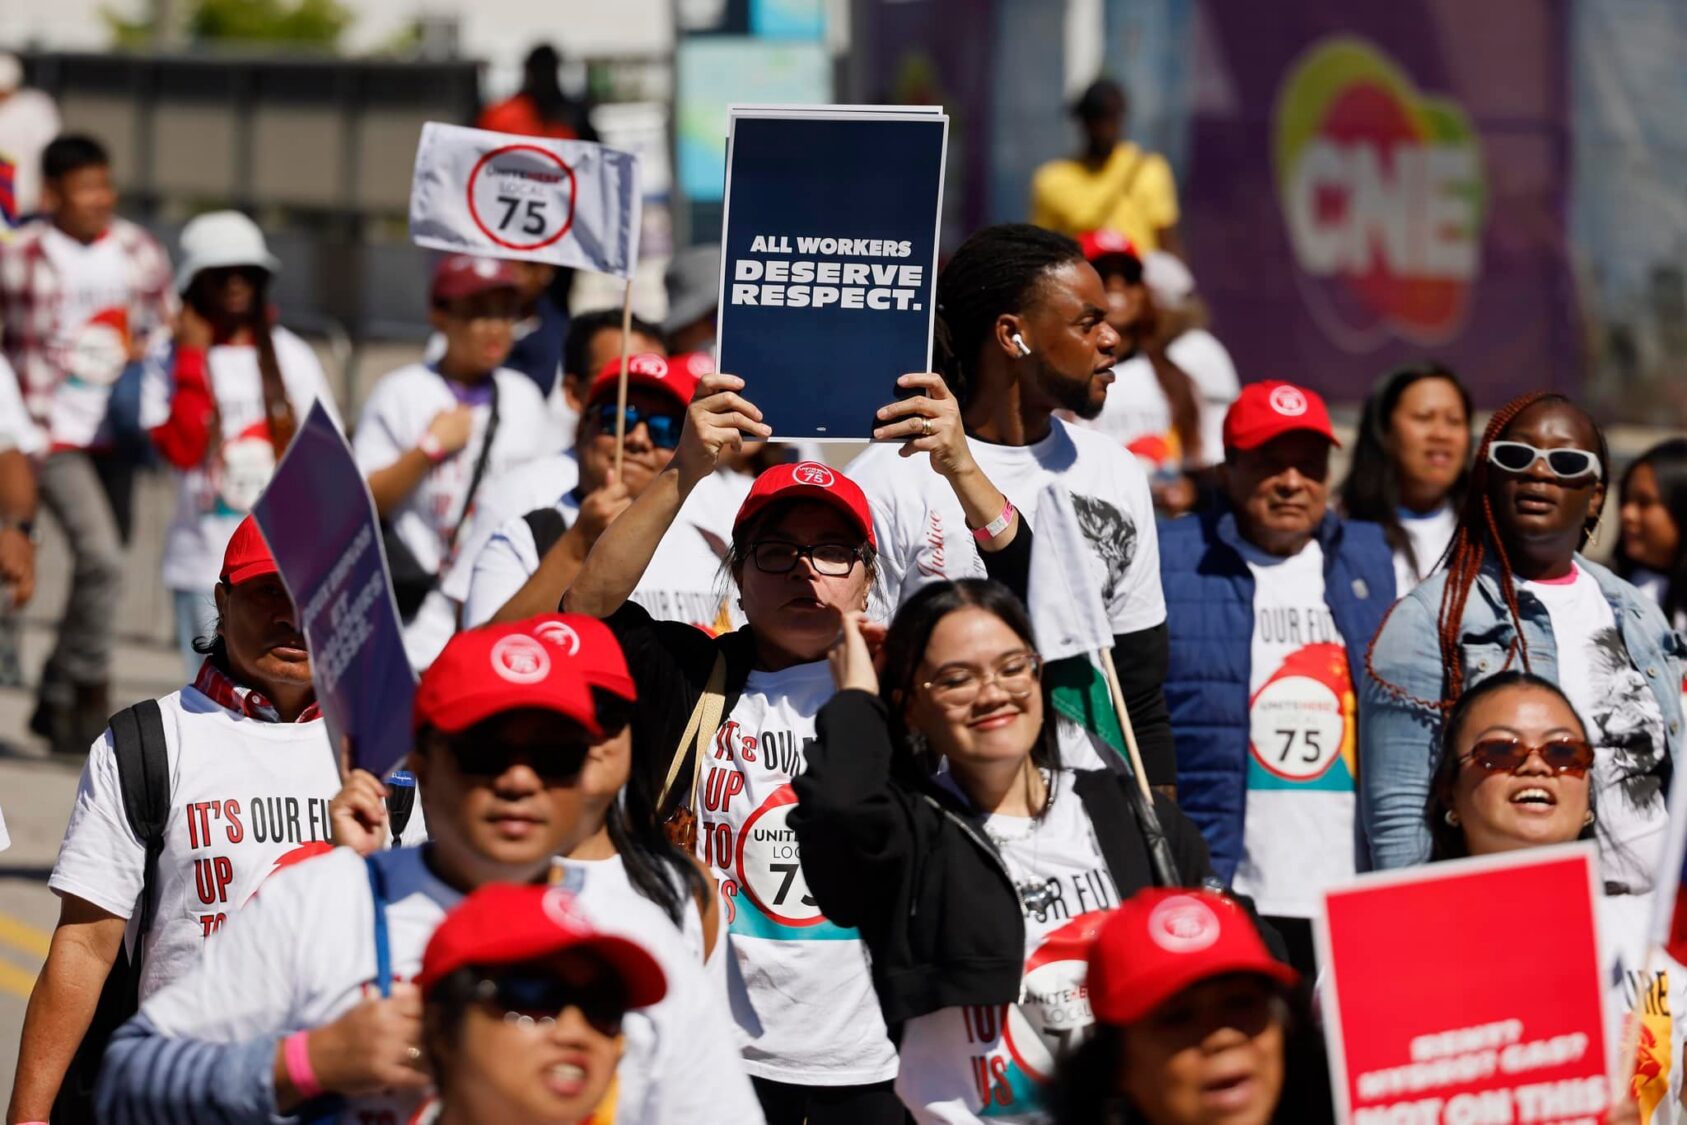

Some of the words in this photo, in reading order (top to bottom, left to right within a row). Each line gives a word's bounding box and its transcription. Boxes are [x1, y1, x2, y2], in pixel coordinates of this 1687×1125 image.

[496, 195, 547, 236] 75
[1289, 139, 1480, 276] CNE
[749, 235, 793, 253] ALL
[797, 236, 912, 258] WORKERS
[734, 259, 924, 287] DESERVE
[731, 283, 922, 311] RESPECT.
[804, 472, 824, 484] 75
[1259, 607, 1302, 644] OUR
[714, 720, 757, 763] IT'S
[1275, 729, 1321, 763] 75
[705, 766, 744, 813] UP
[186, 798, 245, 850] IT'S
[250, 796, 303, 844] OUR
[307, 796, 338, 848] FU
[703, 821, 733, 870] TO
[773, 845, 801, 859] LOC
[194, 855, 234, 905] UP
[712, 878, 738, 925] S
[1071, 869, 1113, 915] FU
[970, 1054, 1013, 1109] US
